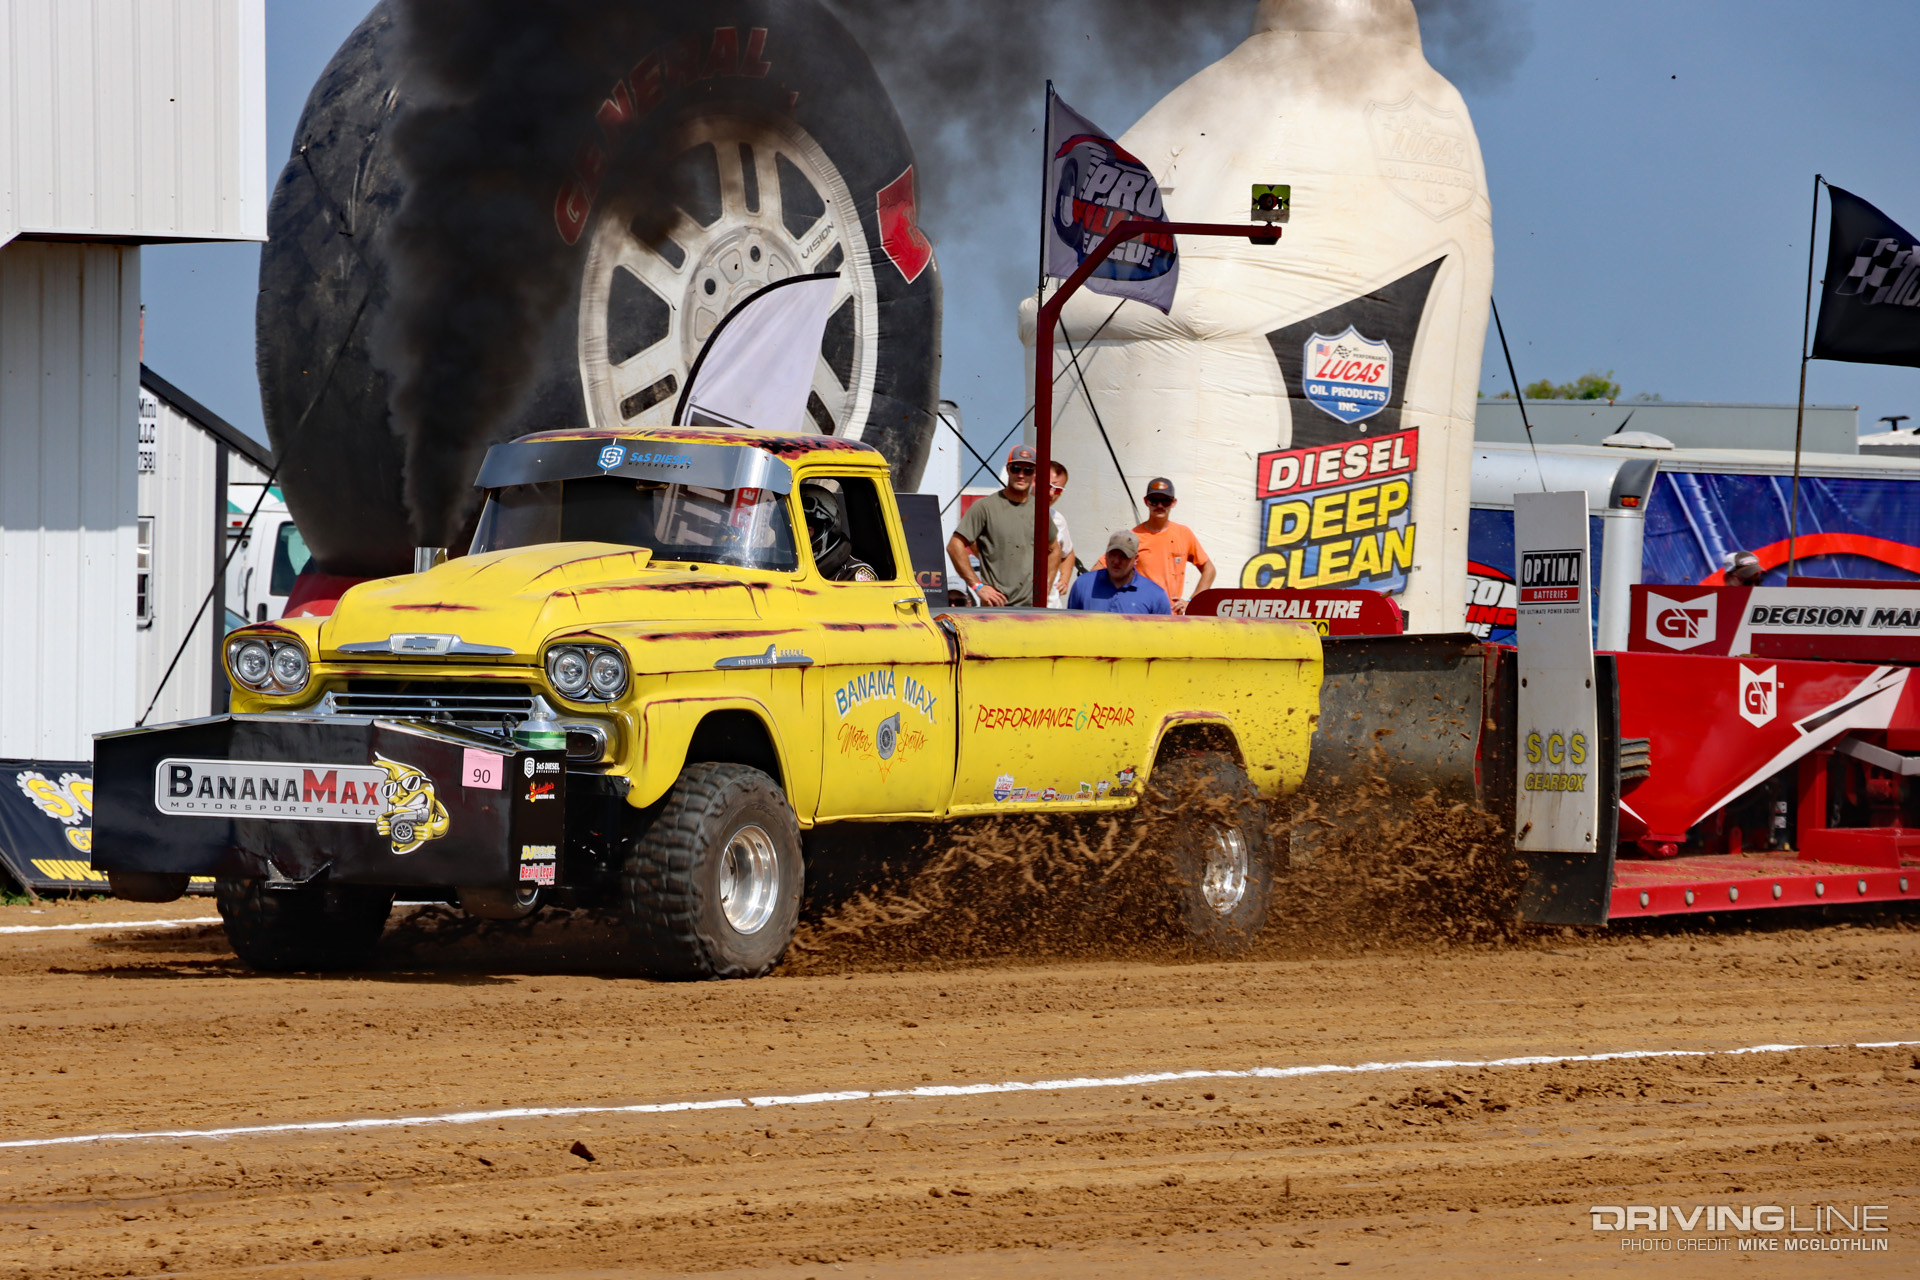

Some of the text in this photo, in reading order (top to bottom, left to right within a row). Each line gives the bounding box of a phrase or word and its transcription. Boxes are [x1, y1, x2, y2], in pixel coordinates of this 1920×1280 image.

[1082, 163, 1163, 219] PRO
[801, 221, 834, 259] VISION
[1315, 359, 1385, 383] LUCAS
[1309, 384, 1386, 402] OIL PRODUCTS
[1338, 402, 1360, 413] INC.
[630, 452, 693, 465] S&S DIESEL
[1267, 437, 1411, 493] DIESEL
[1266, 480, 1410, 548] DEEP
[1241, 524, 1417, 590] CLEAN
[1524, 557, 1578, 584] OPTIMA
[1533, 590, 1568, 600] BATTERIES
[1216, 599, 1363, 619] GENERAL TIRE
[1750, 606, 1864, 628] DECISION
[834, 670, 937, 723] BANANA MAX
[974, 704, 1076, 734] PERFORMANCE
[1087, 702, 1135, 730] REPAIR
[838, 722, 928, 761] Motor Sports
[473, 768, 491, 784] 90
[1525, 773, 1586, 792] GEARBOX
[171, 801, 376, 816] MOTORSPORTS LLC
[521, 865, 555, 879] Bearly Legal
